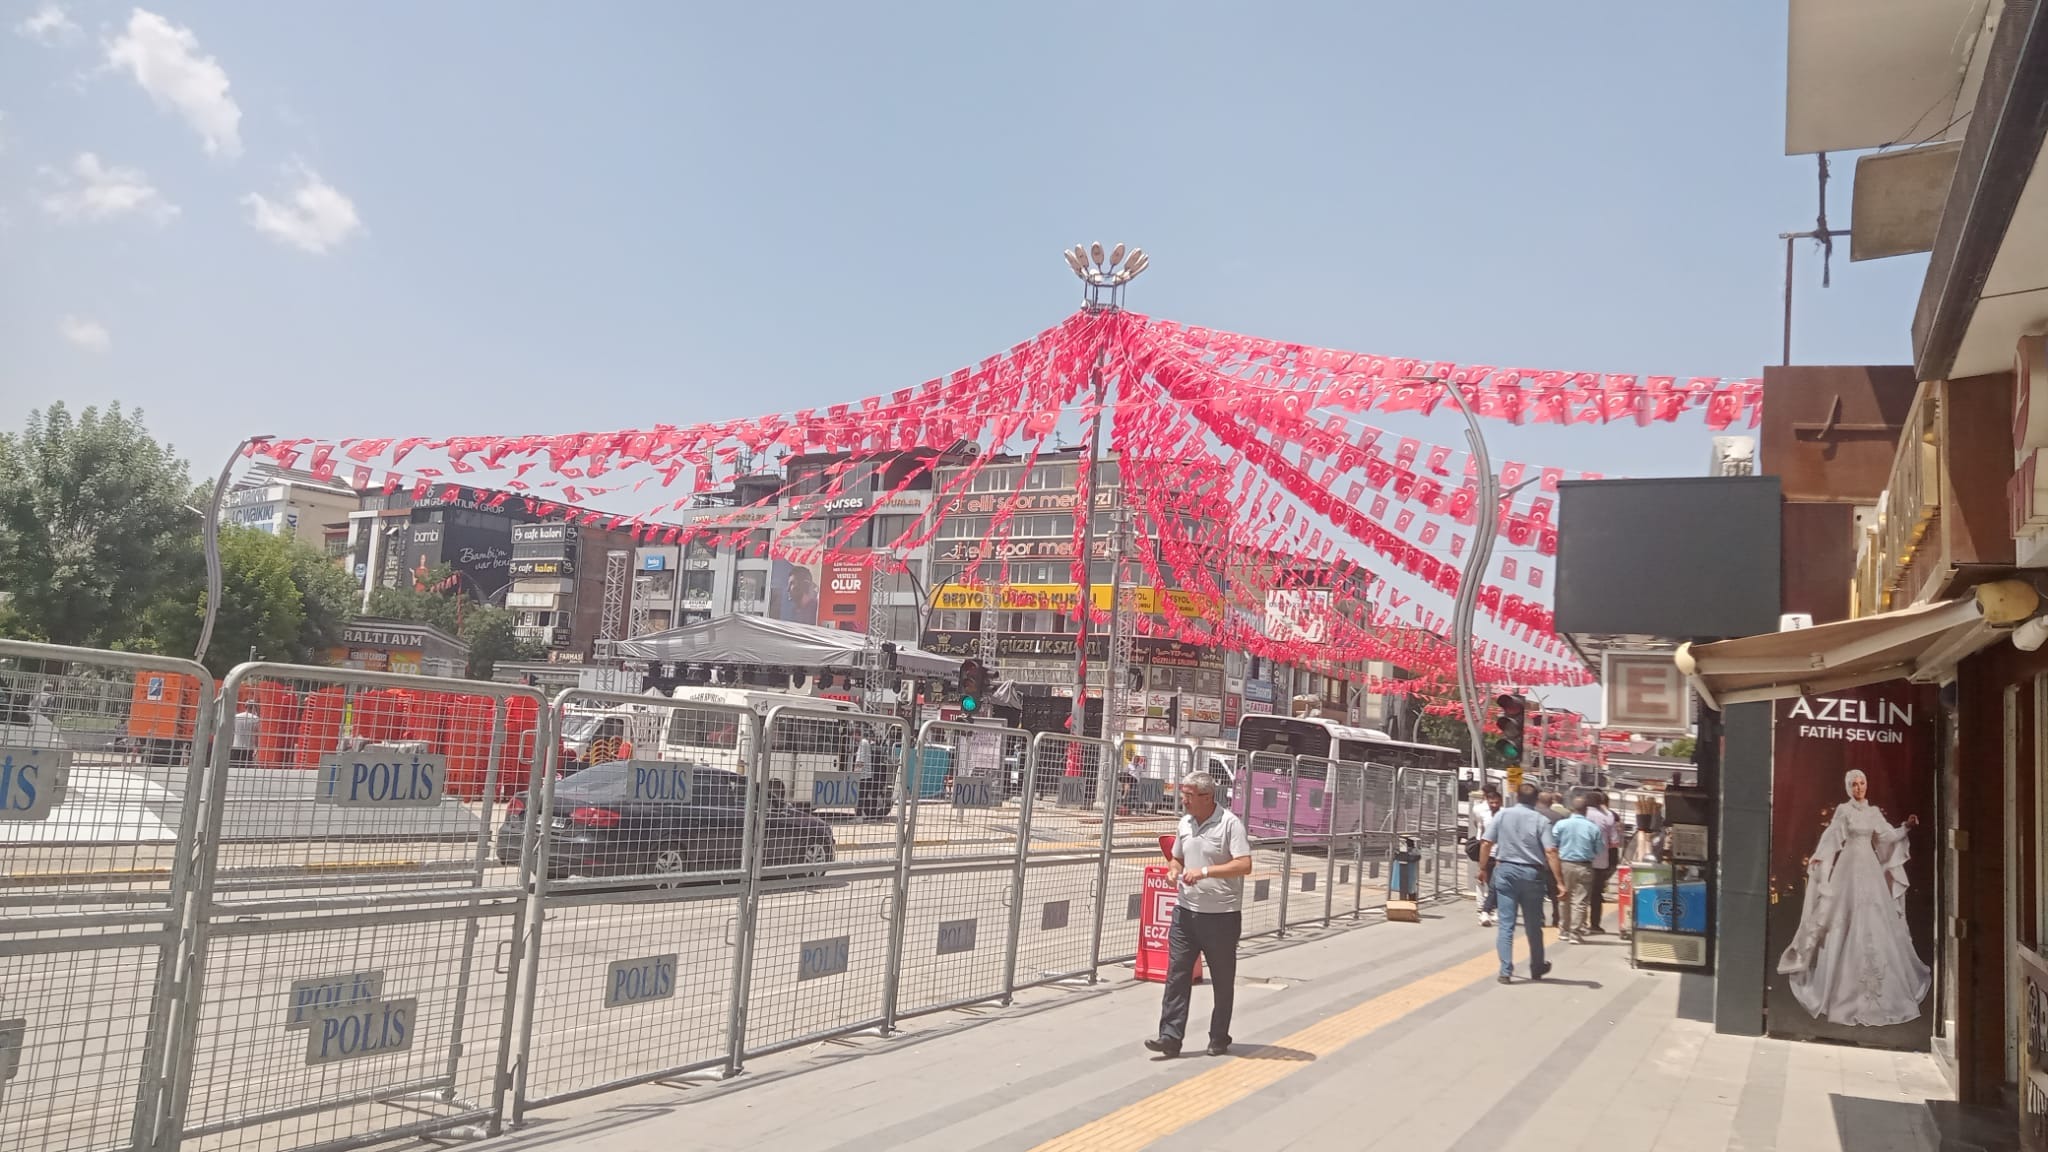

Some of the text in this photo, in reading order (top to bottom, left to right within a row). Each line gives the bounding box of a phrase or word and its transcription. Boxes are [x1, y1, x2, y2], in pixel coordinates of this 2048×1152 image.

[414, 528, 439, 542] bambi
[831, 579, 862, 591] OLUR
[390, 633, 424, 646] AVM
[1626, 667, 1670, 714] E
[1788, 696, 1913, 726] AZELİN
[1800, 724, 1842, 740] FATİH
[347, 756, 435, 802] POLİS
[634, 764, 687, 801] POLİS
[815, 775, 858, 806] POLİS
[955, 780, 990, 806] POLİS
[803, 940, 847, 974] POLİS
[613, 958, 671, 1002] POLİS
[320, 1003, 406, 1057] POLİS
